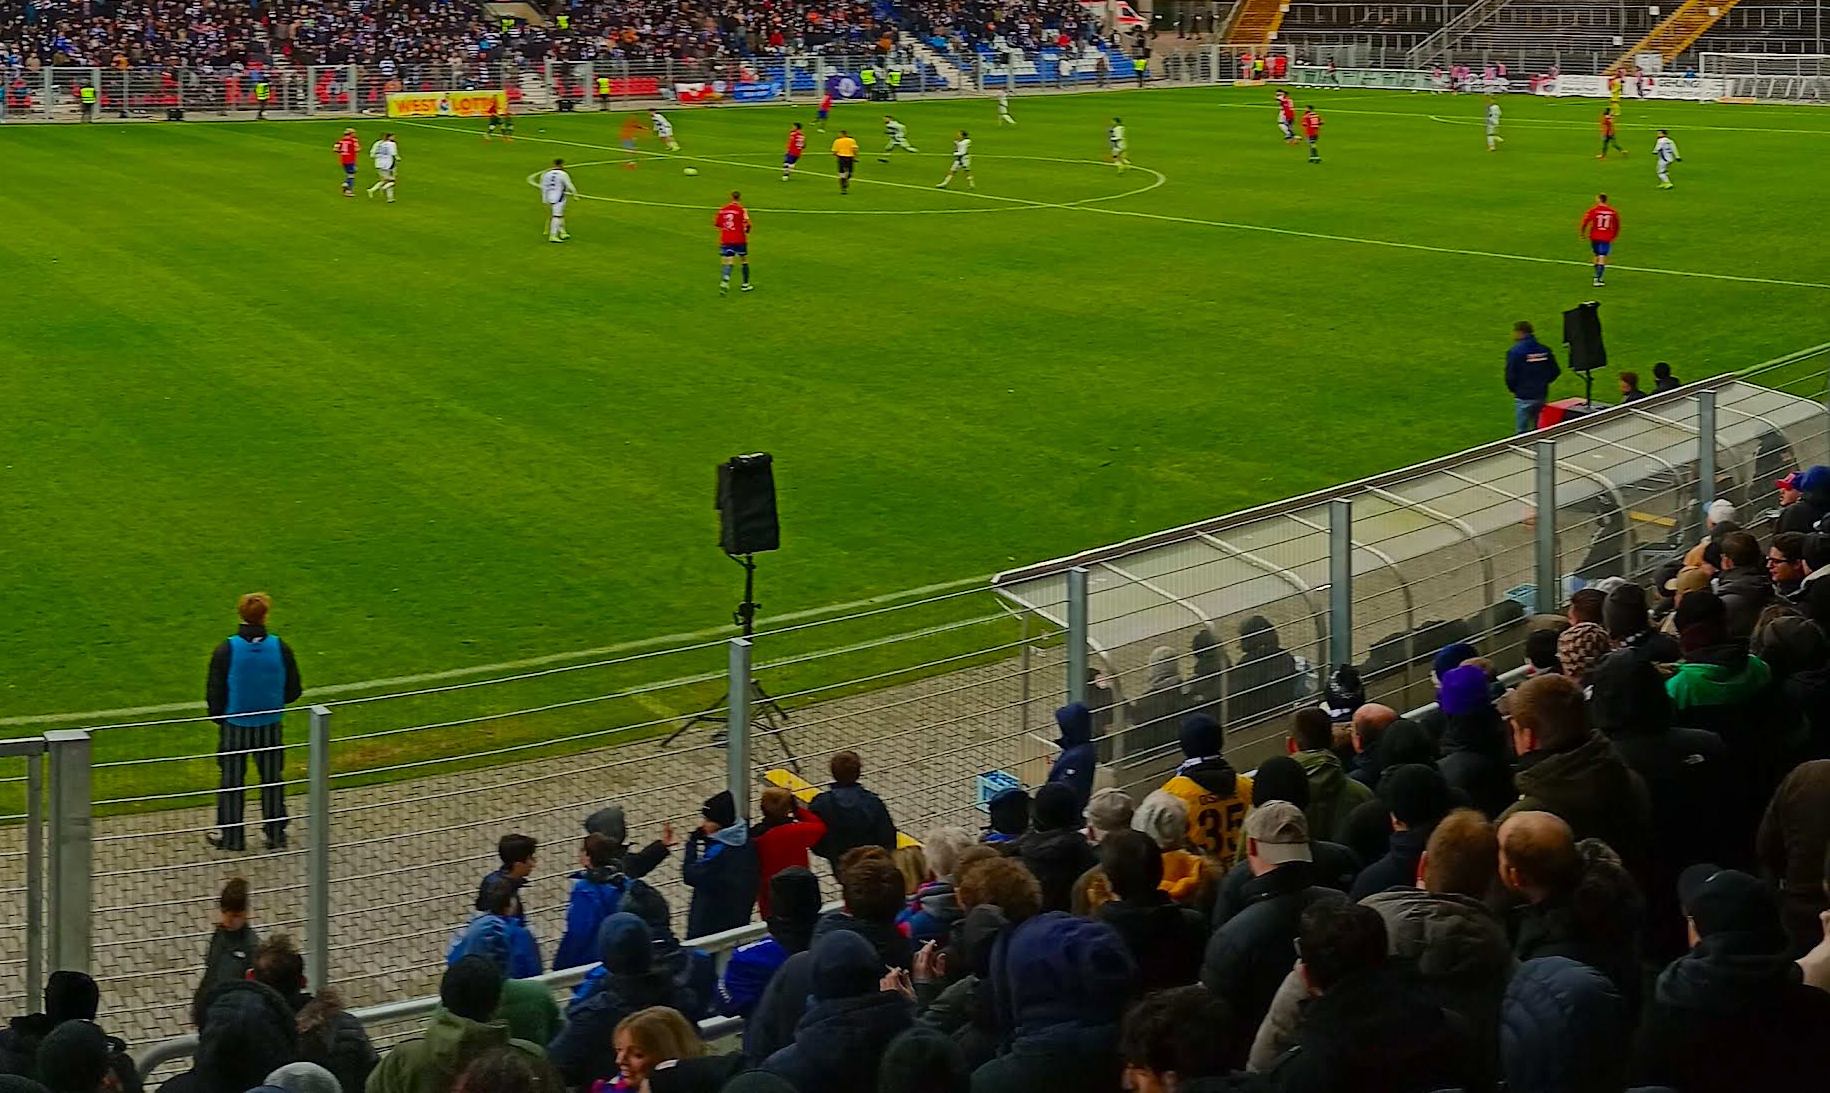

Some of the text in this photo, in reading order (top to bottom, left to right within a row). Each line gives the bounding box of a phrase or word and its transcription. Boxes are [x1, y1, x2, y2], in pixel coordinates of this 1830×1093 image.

[395, 98, 436, 113] WEST
[1595, 214, 1611, 229] 11
[1197, 802, 1244, 855] 35
